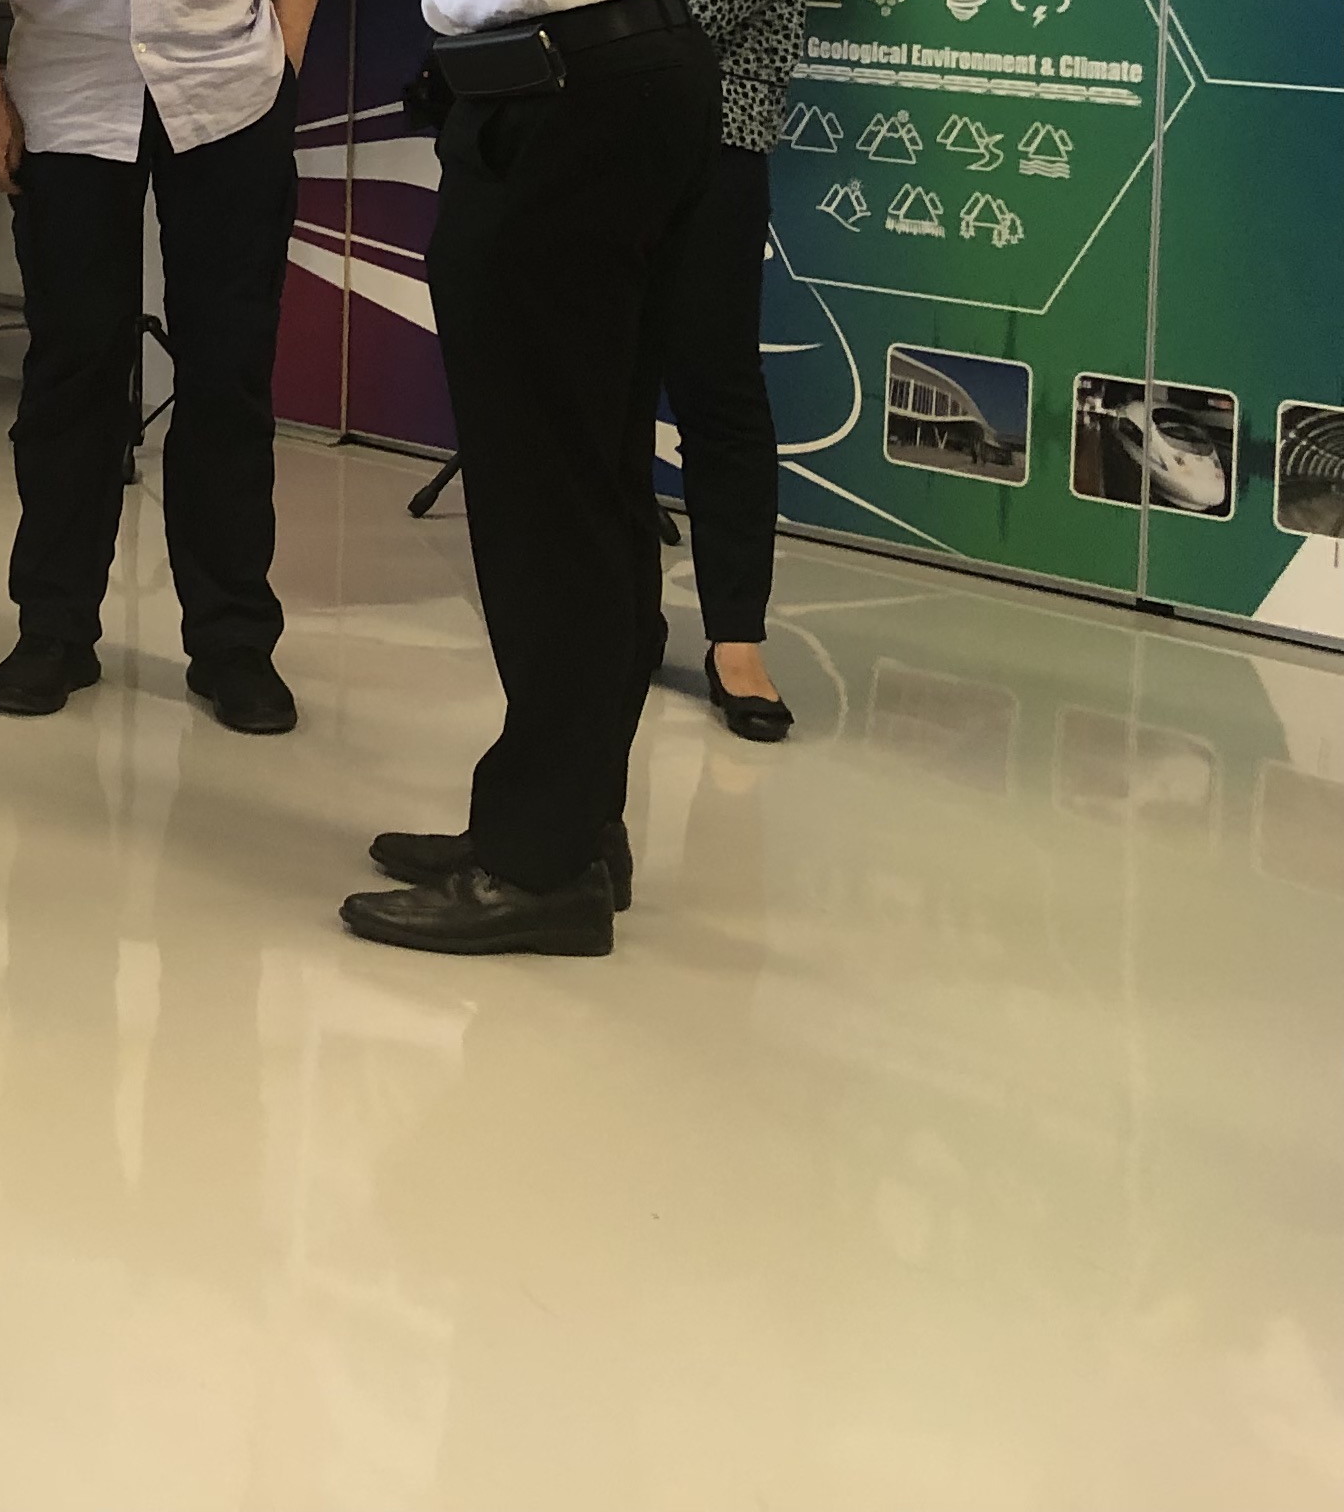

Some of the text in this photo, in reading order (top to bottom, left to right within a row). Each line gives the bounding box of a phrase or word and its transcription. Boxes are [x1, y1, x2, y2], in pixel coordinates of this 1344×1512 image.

[808, 37, 1143, 83] Geological Environment & Climate
